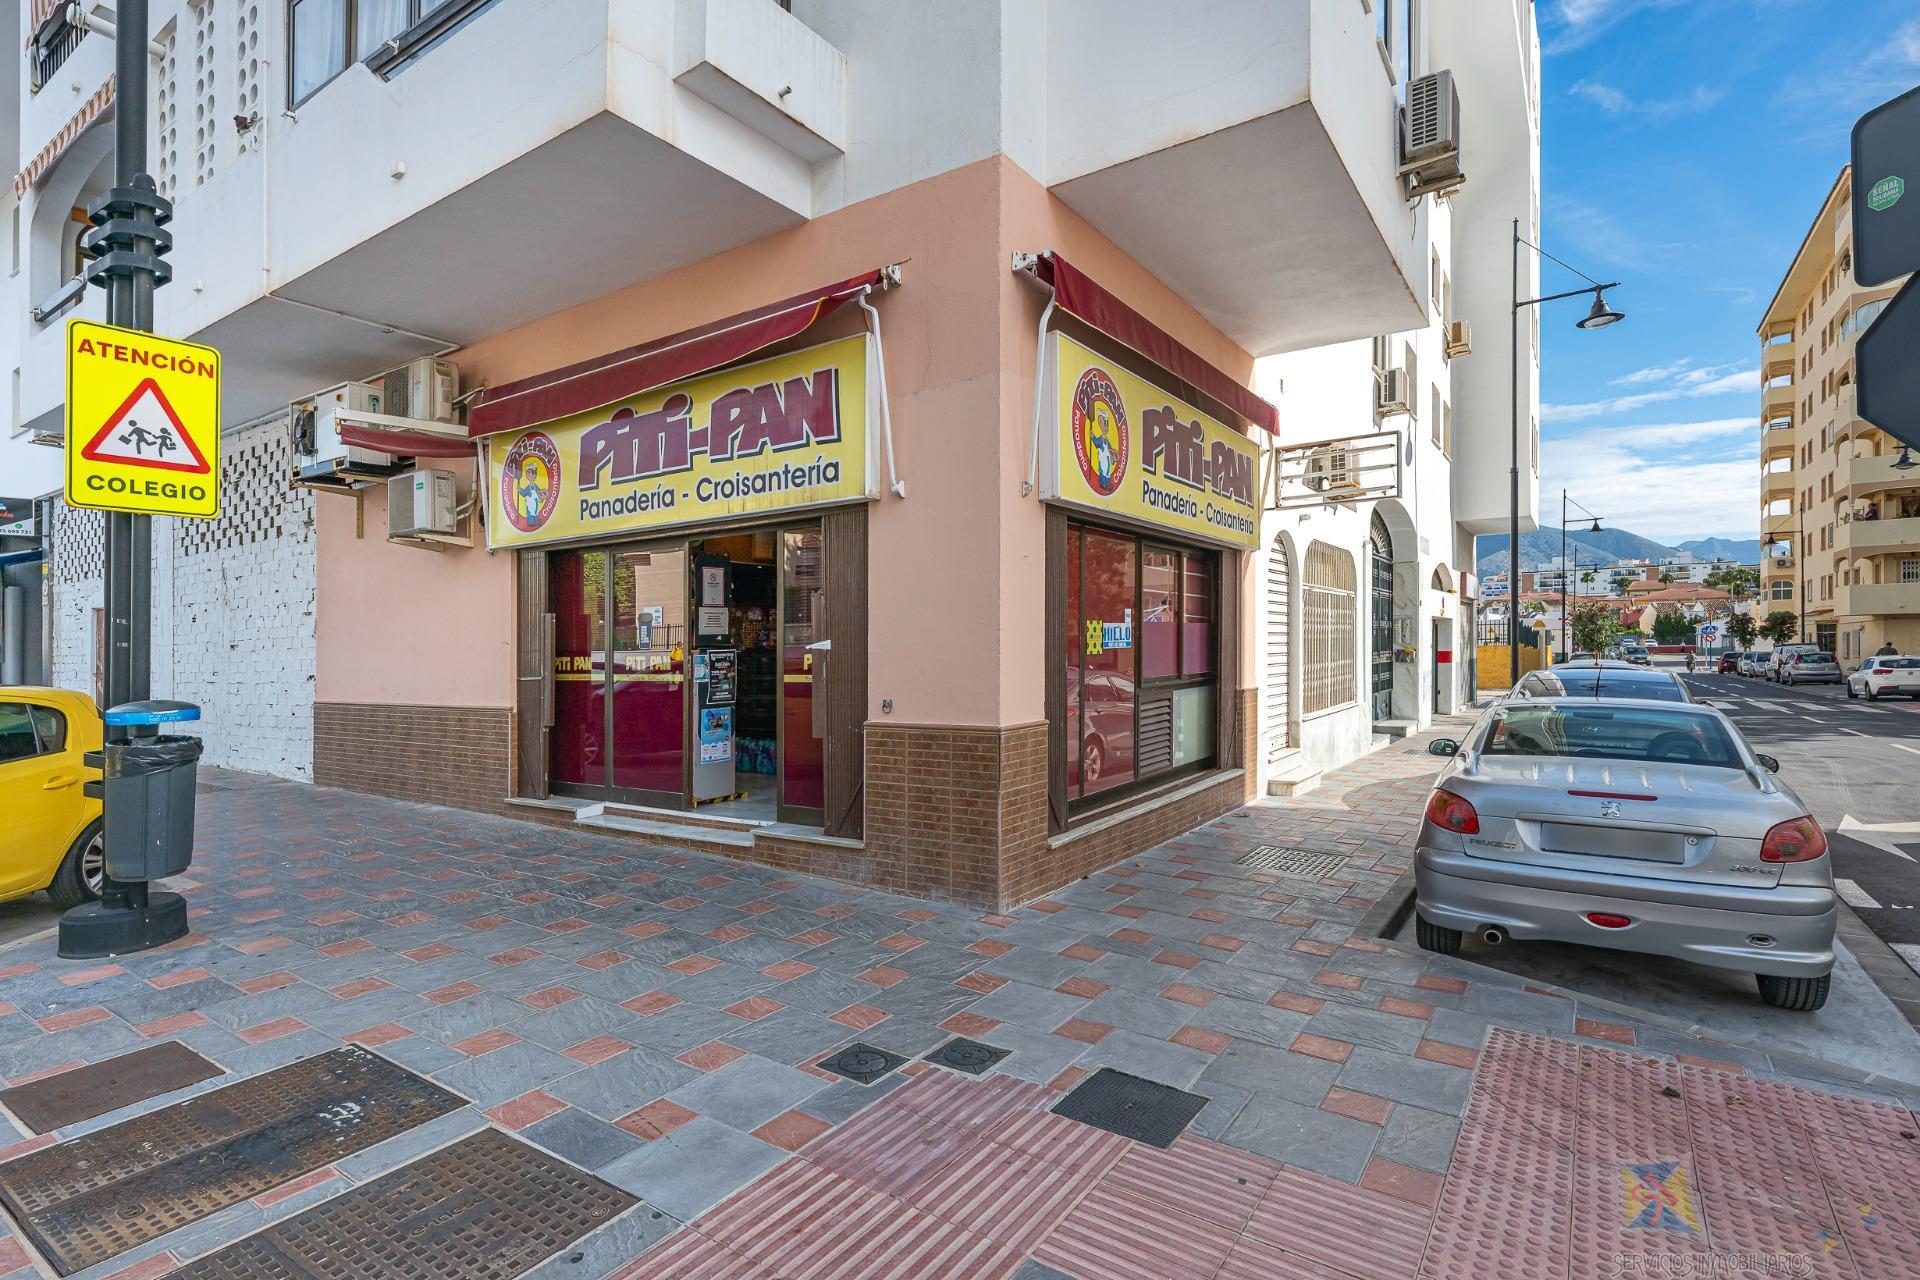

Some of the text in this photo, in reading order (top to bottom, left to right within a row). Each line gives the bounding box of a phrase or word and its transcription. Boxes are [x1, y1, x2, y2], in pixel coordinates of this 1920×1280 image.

[77, 338, 214, 378] ATENCIÓN
[86, 474, 206, 501] COLEGIO
[580, 483, 675, 520] Panadería
[696, 456, 840, 503] Croisantería
[1142, 480, 1197, 517] Panadería
[1206, 502, 1253, 535] Croisantería
[1103, 626, 1131, 641] HIELO
[649, 655, 672, 671] PAN
[1470, 838, 1517, 850] PEUGEOT
